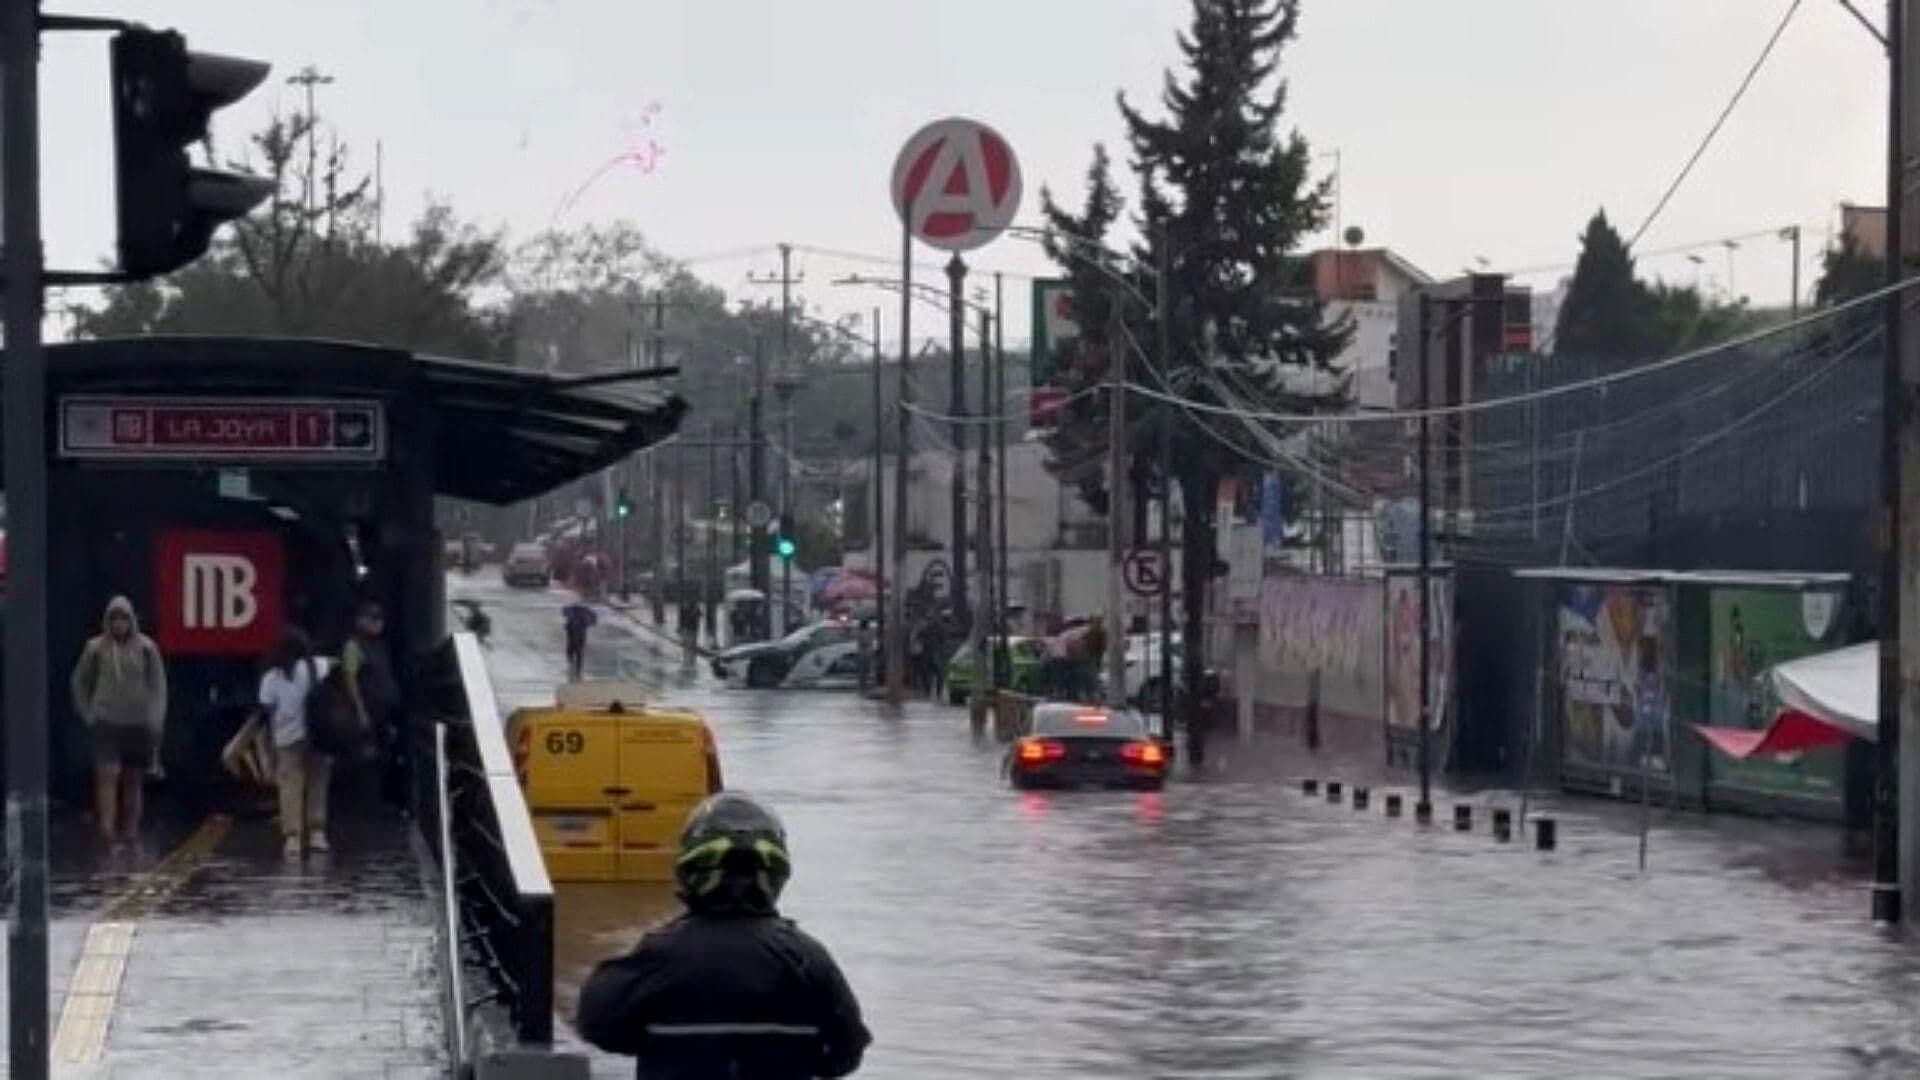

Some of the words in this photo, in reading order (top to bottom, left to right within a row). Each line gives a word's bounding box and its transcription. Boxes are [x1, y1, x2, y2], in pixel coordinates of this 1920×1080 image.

[905, 121, 1005, 243] A
[169, 418, 201, 438] LA
[207, 418, 275, 438] JOYA
[182, 553, 257, 629] MB
[545, 730, 584, 755] 69
